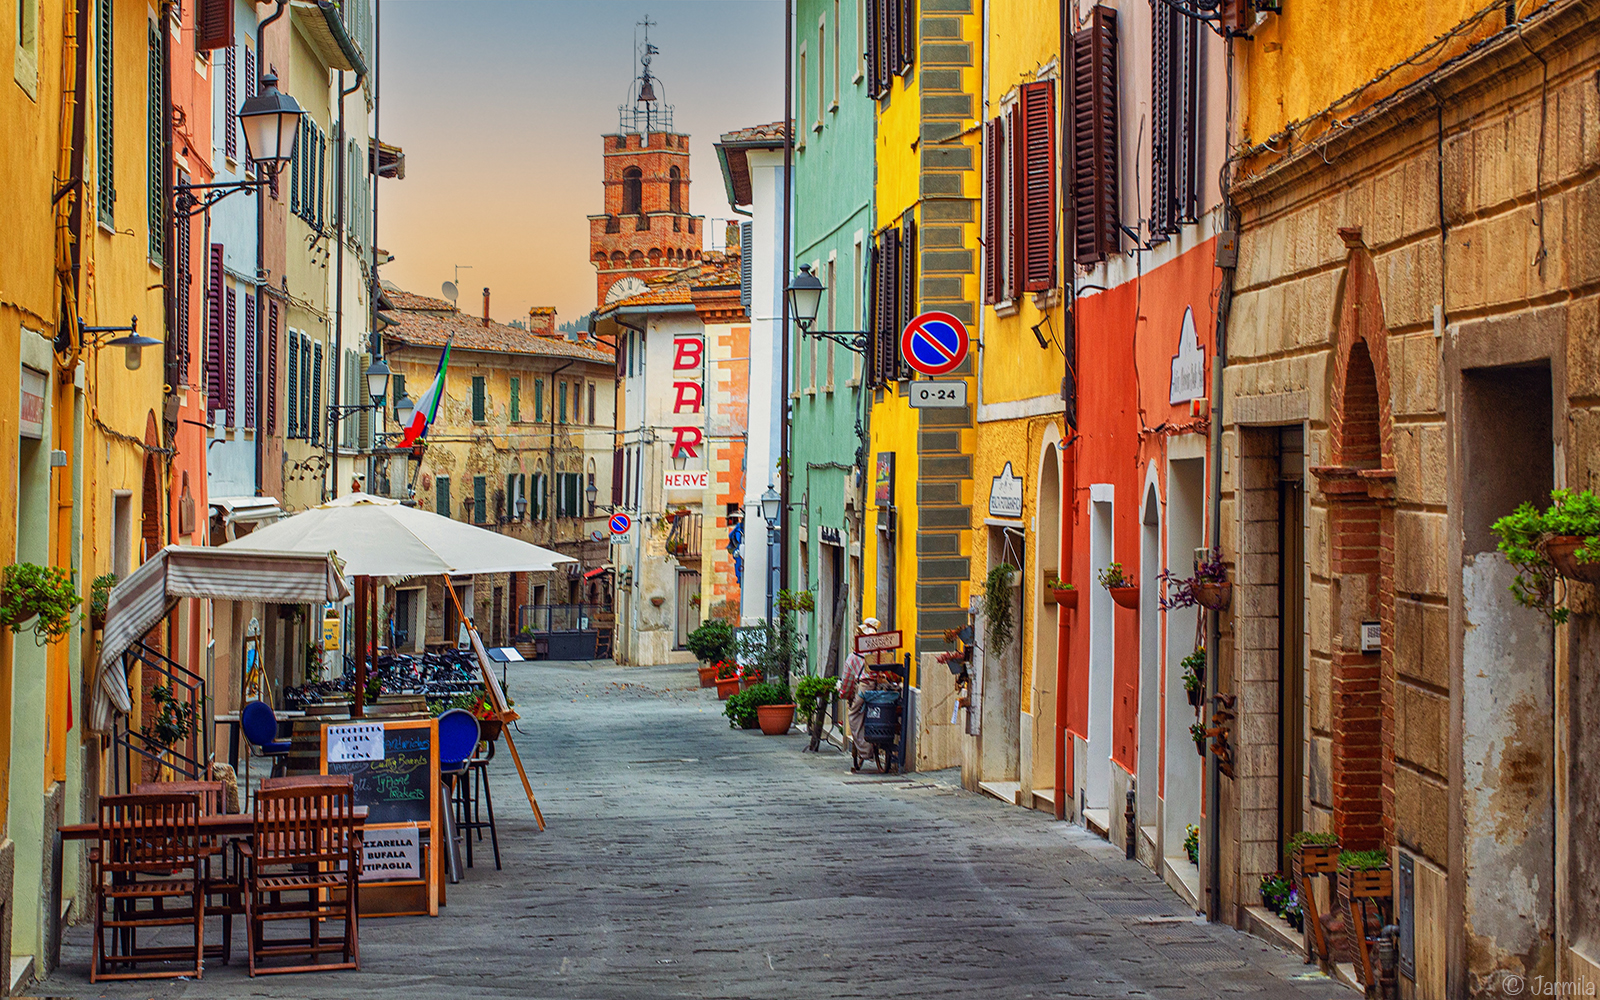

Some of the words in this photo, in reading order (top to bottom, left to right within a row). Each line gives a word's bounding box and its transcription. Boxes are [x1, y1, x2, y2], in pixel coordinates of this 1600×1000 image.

[672, 338, 704, 458] BAR
[920, 389, 956, 400] 0-24
[363, 839, 413, 848] ZZARELLA
[367, 851, 406, 860] BUFALA
[363, 862, 412, 871] TTIPAGLIA
